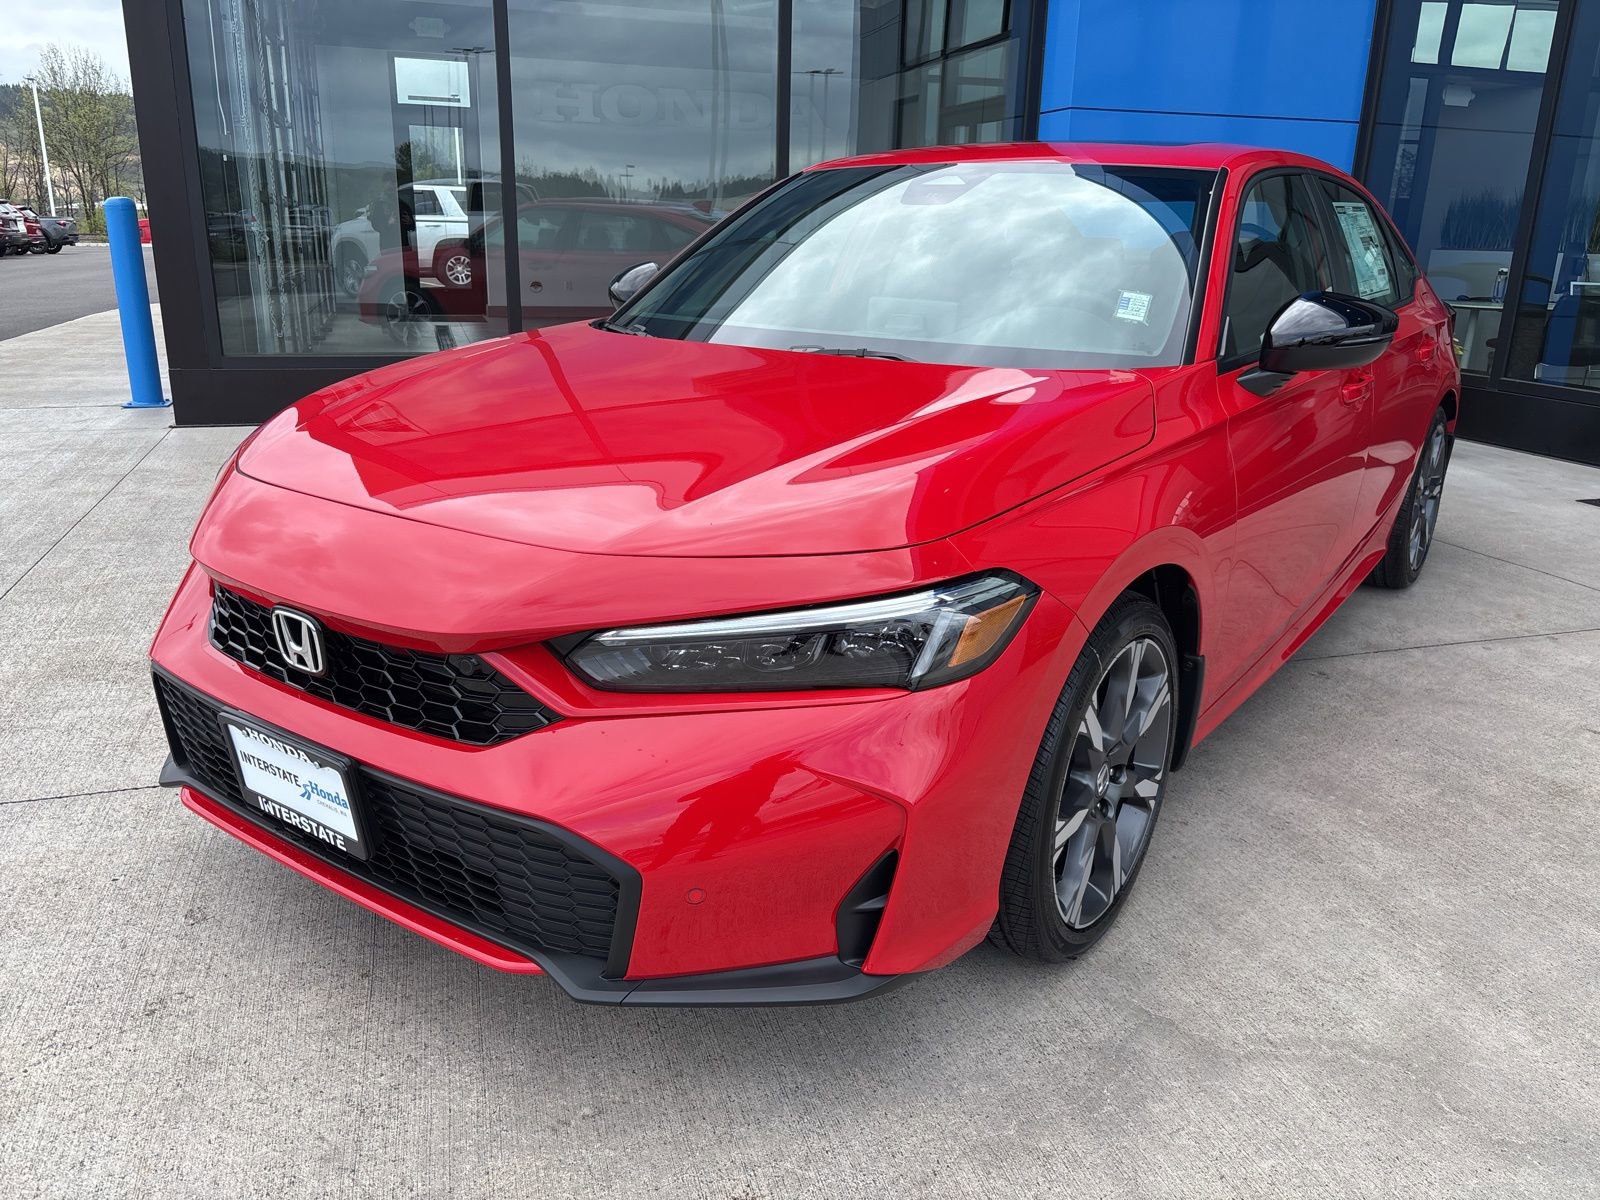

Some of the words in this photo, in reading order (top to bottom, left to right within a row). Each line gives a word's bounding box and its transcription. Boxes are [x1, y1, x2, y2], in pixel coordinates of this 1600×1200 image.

[245, 727, 313, 764] HONDA
[239, 750, 301, 788] INTERSTATE
[308, 780, 349, 810] Honda
[257, 795, 347, 851] INTERSTATE
